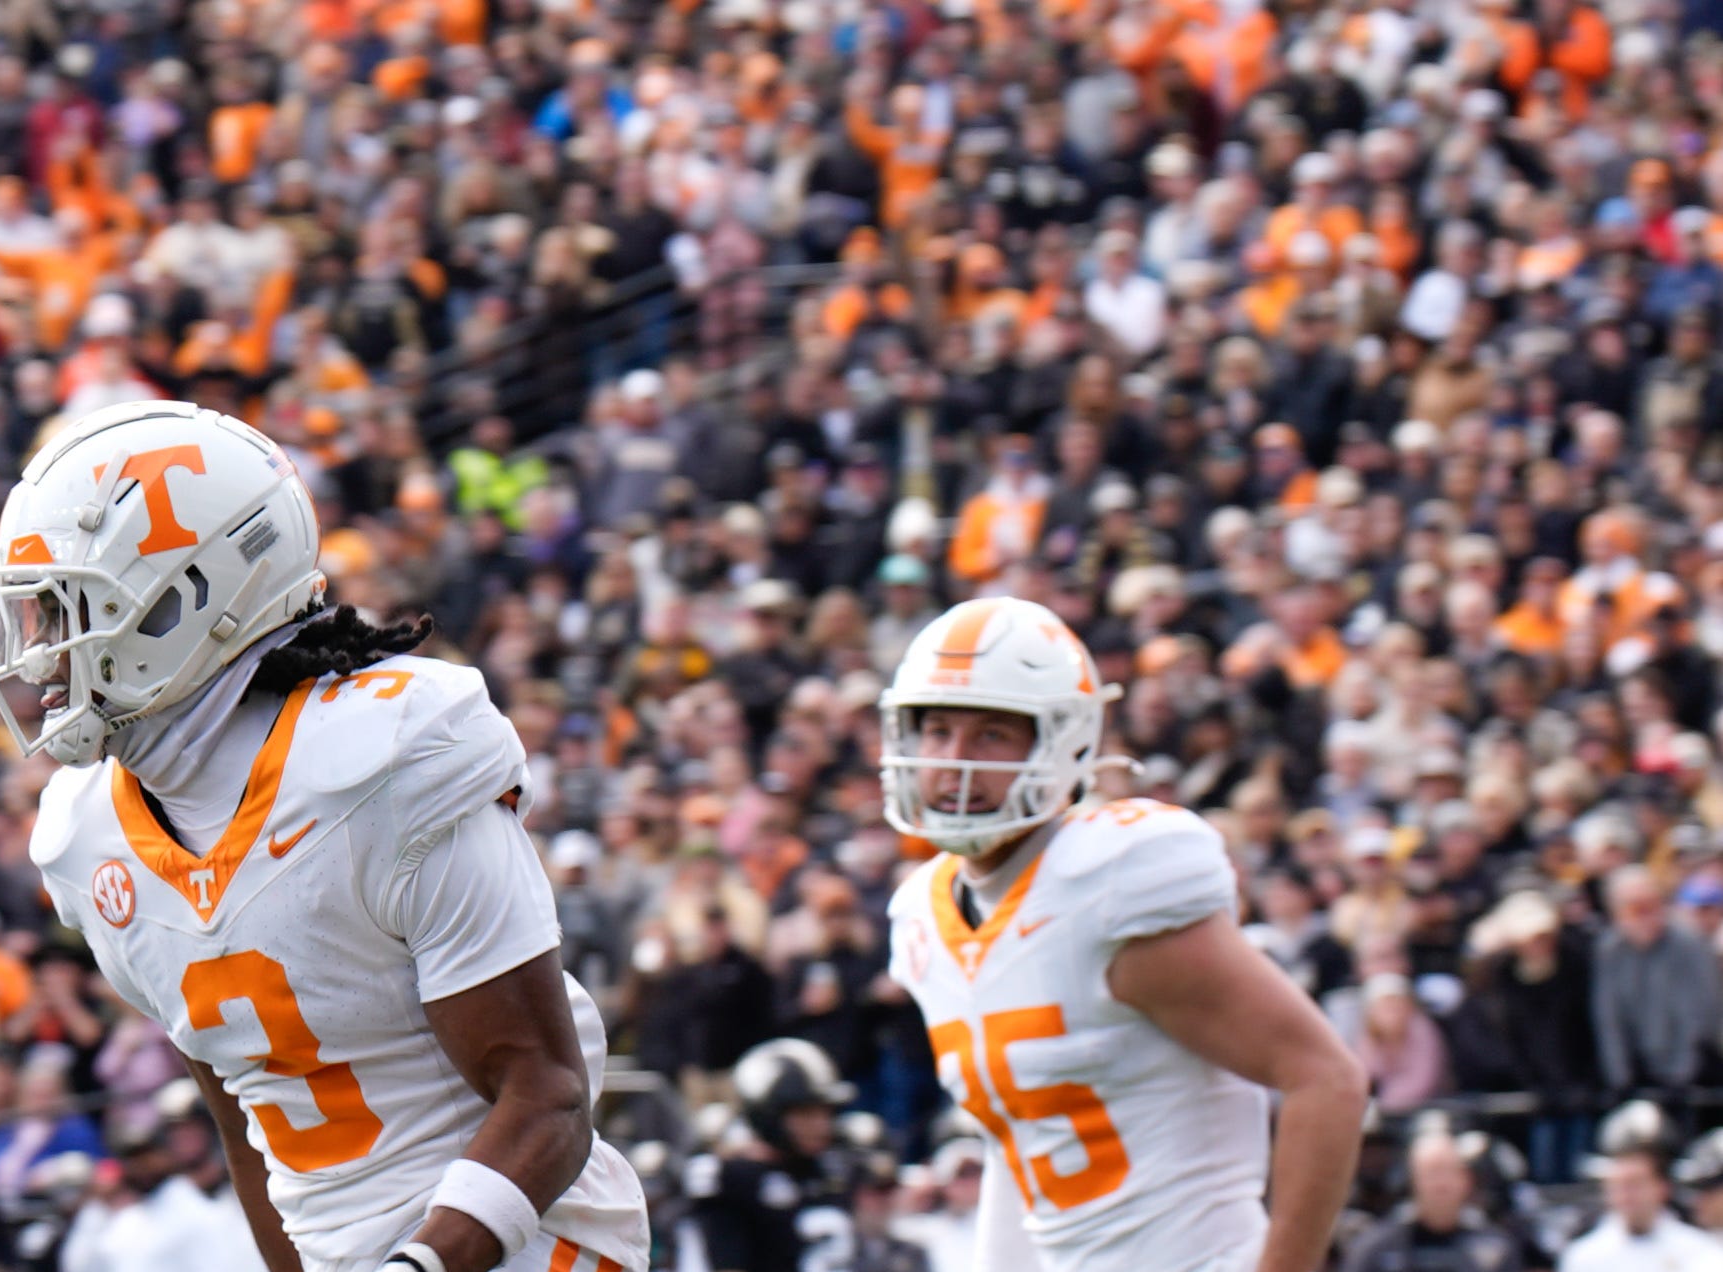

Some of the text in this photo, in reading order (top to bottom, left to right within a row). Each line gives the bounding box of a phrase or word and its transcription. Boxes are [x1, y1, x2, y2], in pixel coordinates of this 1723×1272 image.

[93, 444, 206, 557] T
[95, 864, 132, 923] SEC
[189, 868, 216, 910] T
[180, 949, 384, 1173] 3
